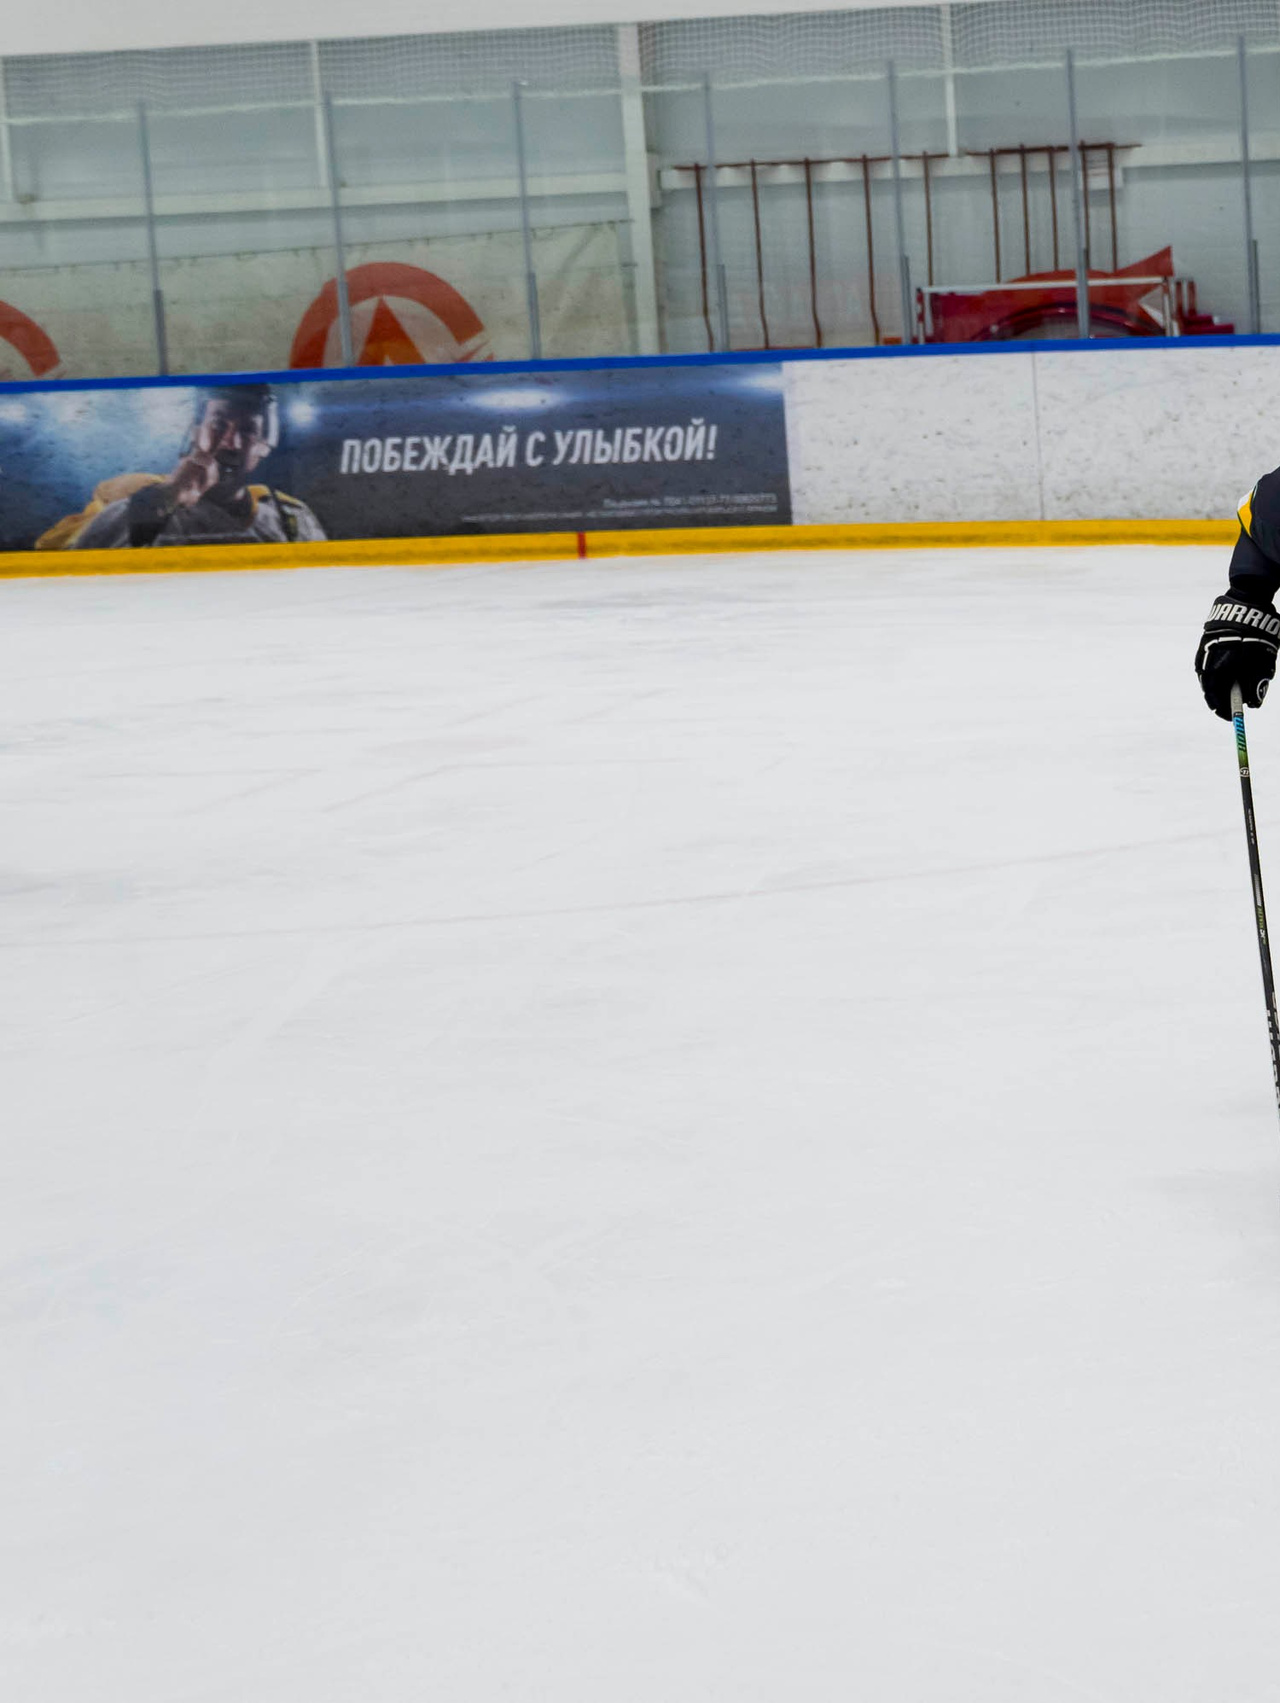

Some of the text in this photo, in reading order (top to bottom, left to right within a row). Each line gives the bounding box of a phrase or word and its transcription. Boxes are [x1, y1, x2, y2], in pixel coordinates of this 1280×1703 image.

[340, 417, 718, 476] ПОБЕЖДАЙ С УЛЫБКОЙ!
